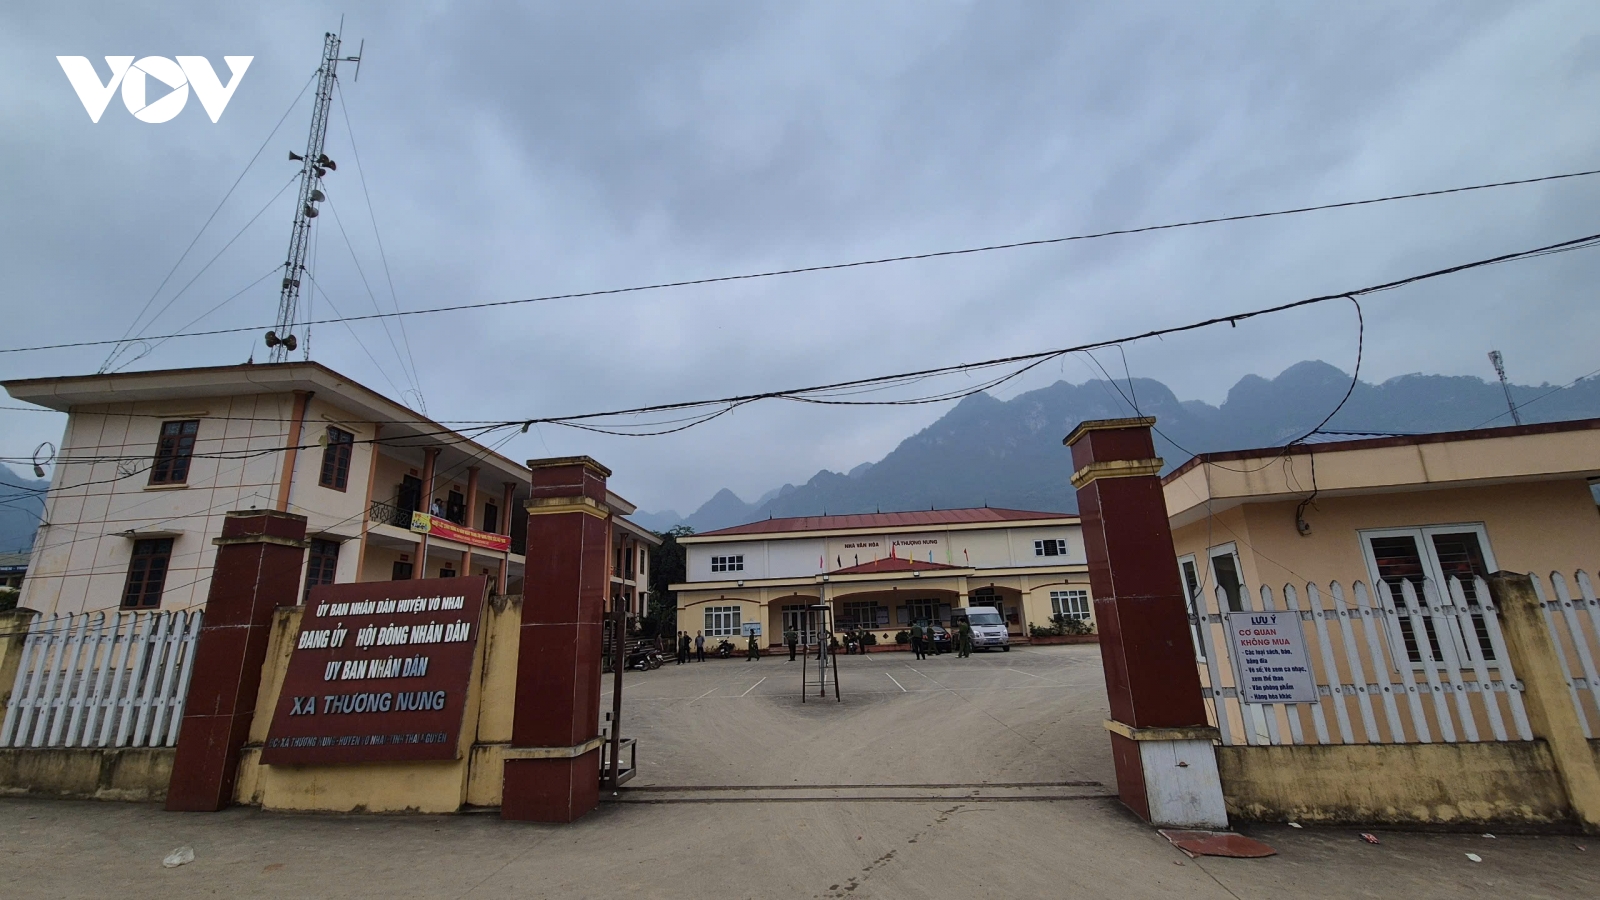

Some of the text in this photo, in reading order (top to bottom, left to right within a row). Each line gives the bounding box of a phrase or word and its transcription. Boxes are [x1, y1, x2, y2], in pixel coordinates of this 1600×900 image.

[316, 595, 464, 617] ỦY BAN NHÂN DÂN HUYỆN VÕ NHAI
[1251, 614, 1276, 624] LƯU Ý
[330, 622, 348, 648] ỦY
[355, 623, 378, 650] HỘI
[409, 620, 444, 644] NHÂN
[444, 619, 470, 643] DÂN
[1241, 638, 1290, 646] KHÔNG MUA
[341, 660, 367, 680] BAN
[367, 655, 402, 679] NHÂN
[402, 654, 429, 678] DÂN
[395, 691, 446, 711] NUNG
